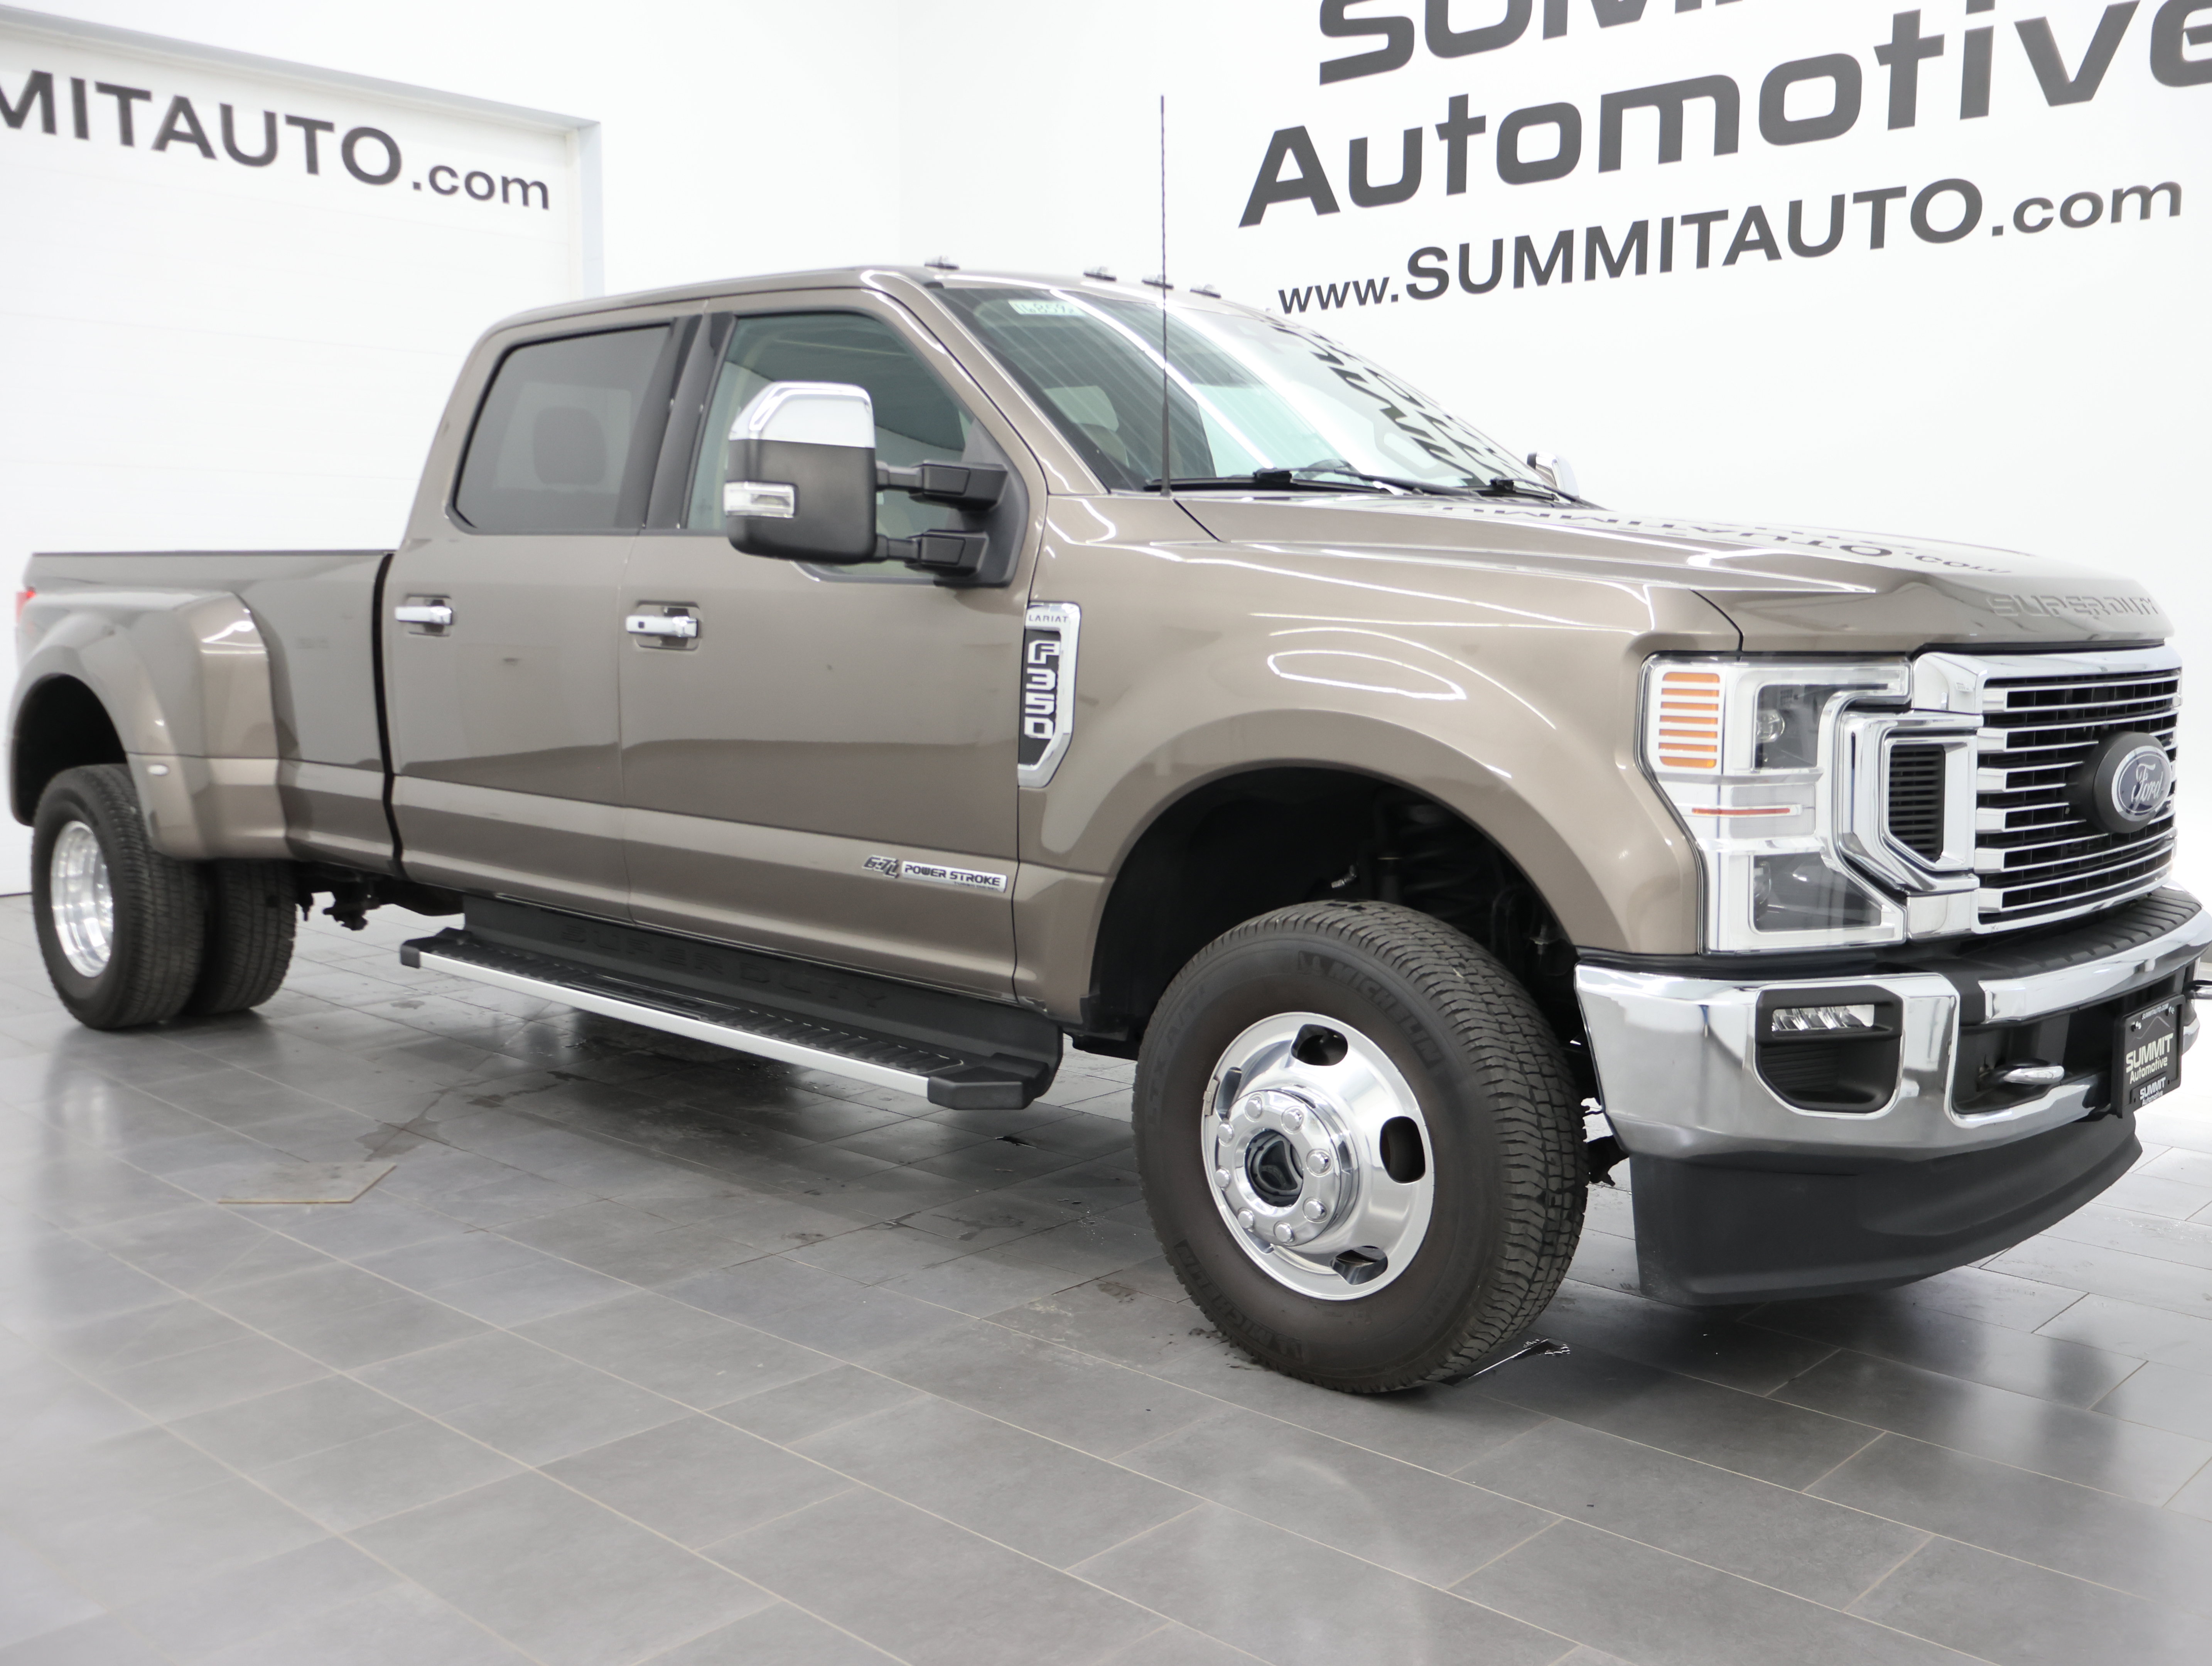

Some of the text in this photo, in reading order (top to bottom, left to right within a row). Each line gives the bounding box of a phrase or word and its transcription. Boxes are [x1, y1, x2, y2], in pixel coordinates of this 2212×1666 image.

[1239, 0, 2212, 228] Automotive
[1277, 177, 2183, 315] www.SUMMITAUTO.com
[1028, 615, 1068, 624] LARIAT
[2131, 763, 2163, 803] Ford
[905, 864, 946, 878] POWER
[950, 871, 1001, 886] STROKE
[1325, 958, 1445, 1069] MICHELIN
[2126, 1033, 2173, 1073] SUMMIT
[2129, 1056, 2168, 1084] Automotive
[2140, 1077, 2166, 1100] SUMMIT
